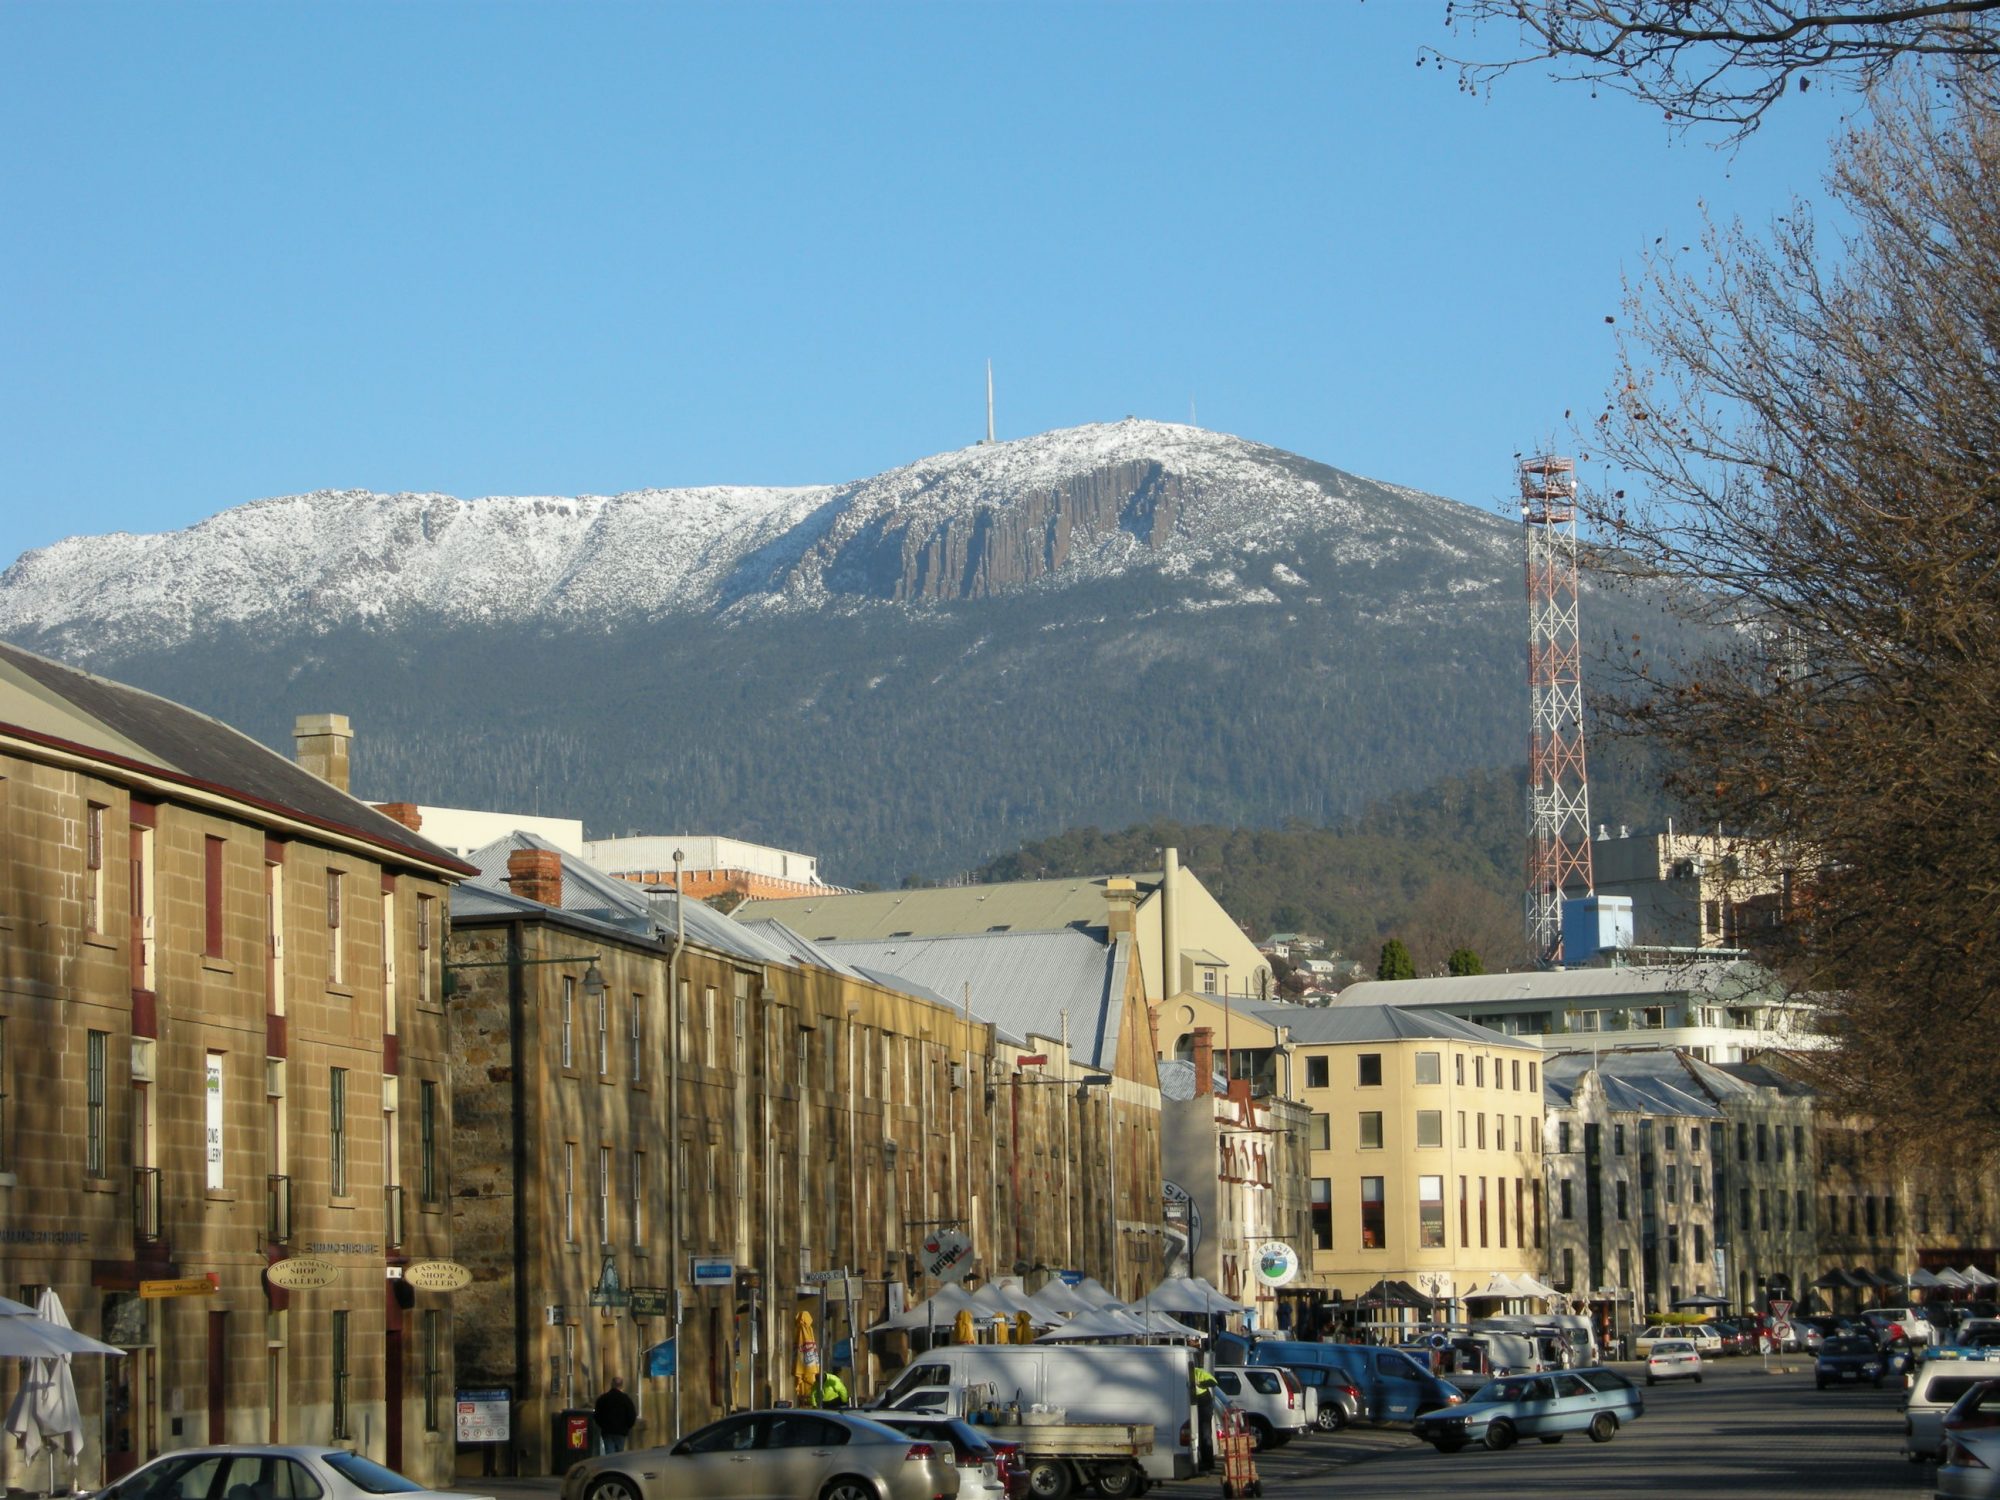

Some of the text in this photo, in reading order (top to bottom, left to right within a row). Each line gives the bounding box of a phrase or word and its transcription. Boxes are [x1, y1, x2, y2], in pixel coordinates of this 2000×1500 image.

[1258, 1243, 1291, 1256] FRESH
[293, 1260, 334, 1273] TASMANIA
[930, 1244, 961, 1277] grape
[290, 1267, 317, 1275] SHOP
[413, 1263, 465, 1276] TASMANIA
[420, 1271, 446, 1279] SHOP
[415, 1279, 459, 1287] GALLERY
